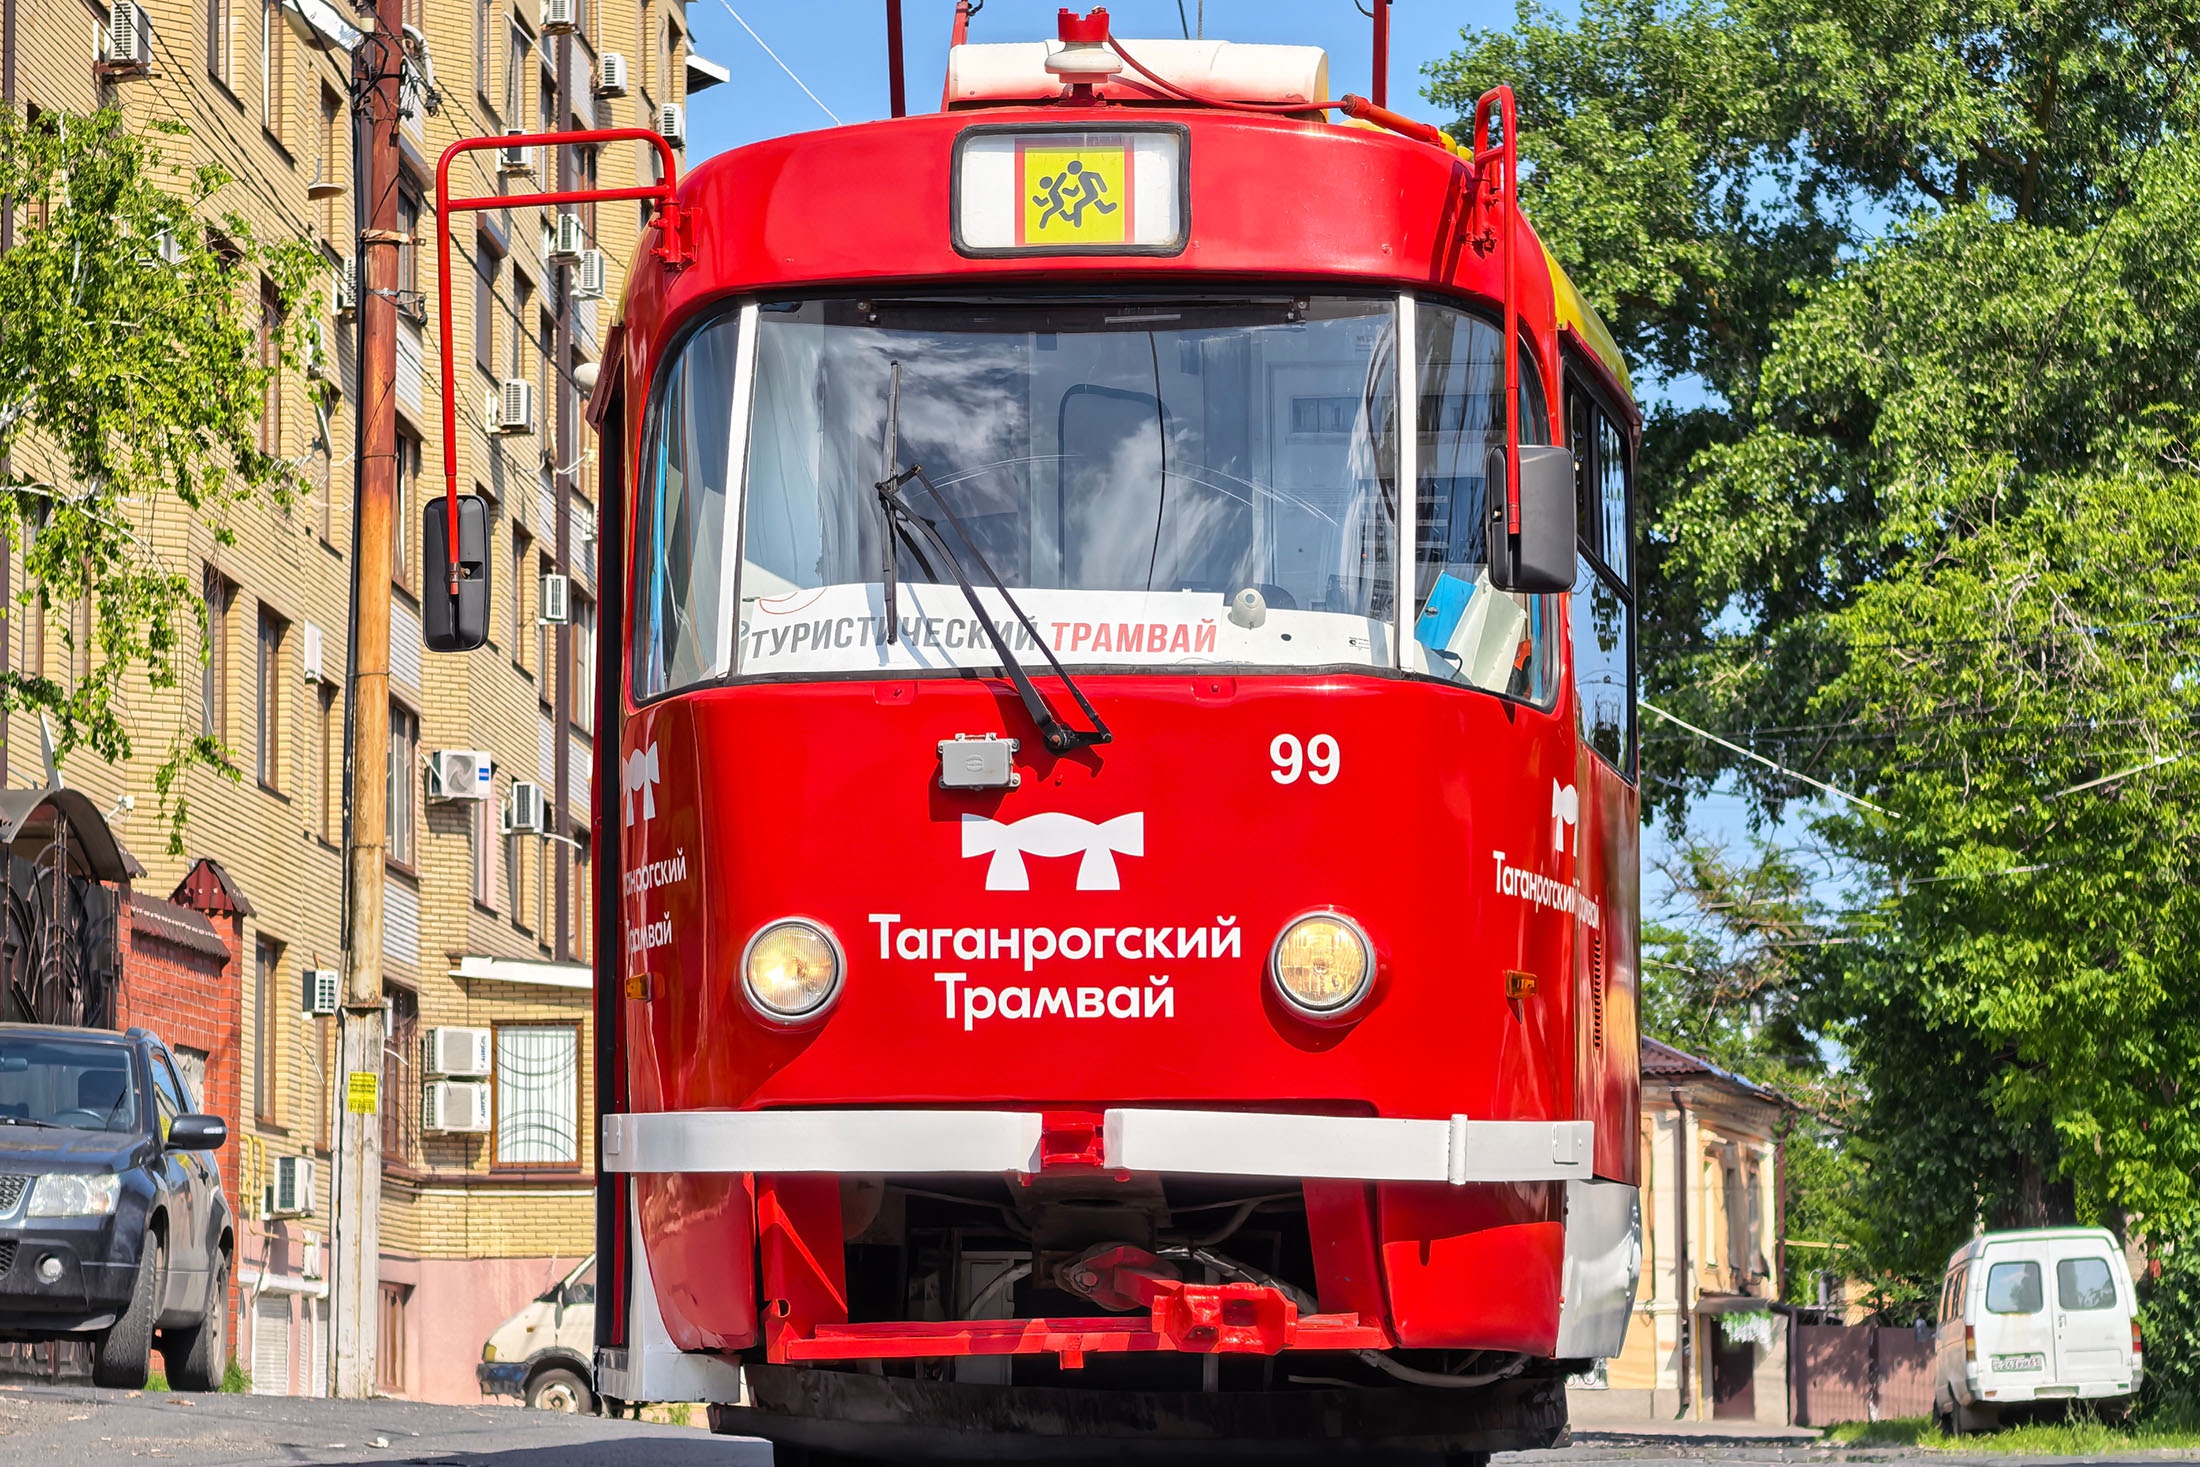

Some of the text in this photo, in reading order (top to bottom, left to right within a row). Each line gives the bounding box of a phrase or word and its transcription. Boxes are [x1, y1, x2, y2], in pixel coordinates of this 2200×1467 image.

[1051, 618, 1217, 653] ТРАМВАЙ
[1269, 733, 1341, 785] 99
[624, 847, 687, 902] анрогский
[868, 913, 1242, 972] Таганрогский
[934, 974, 1175, 1031] Трамвай
